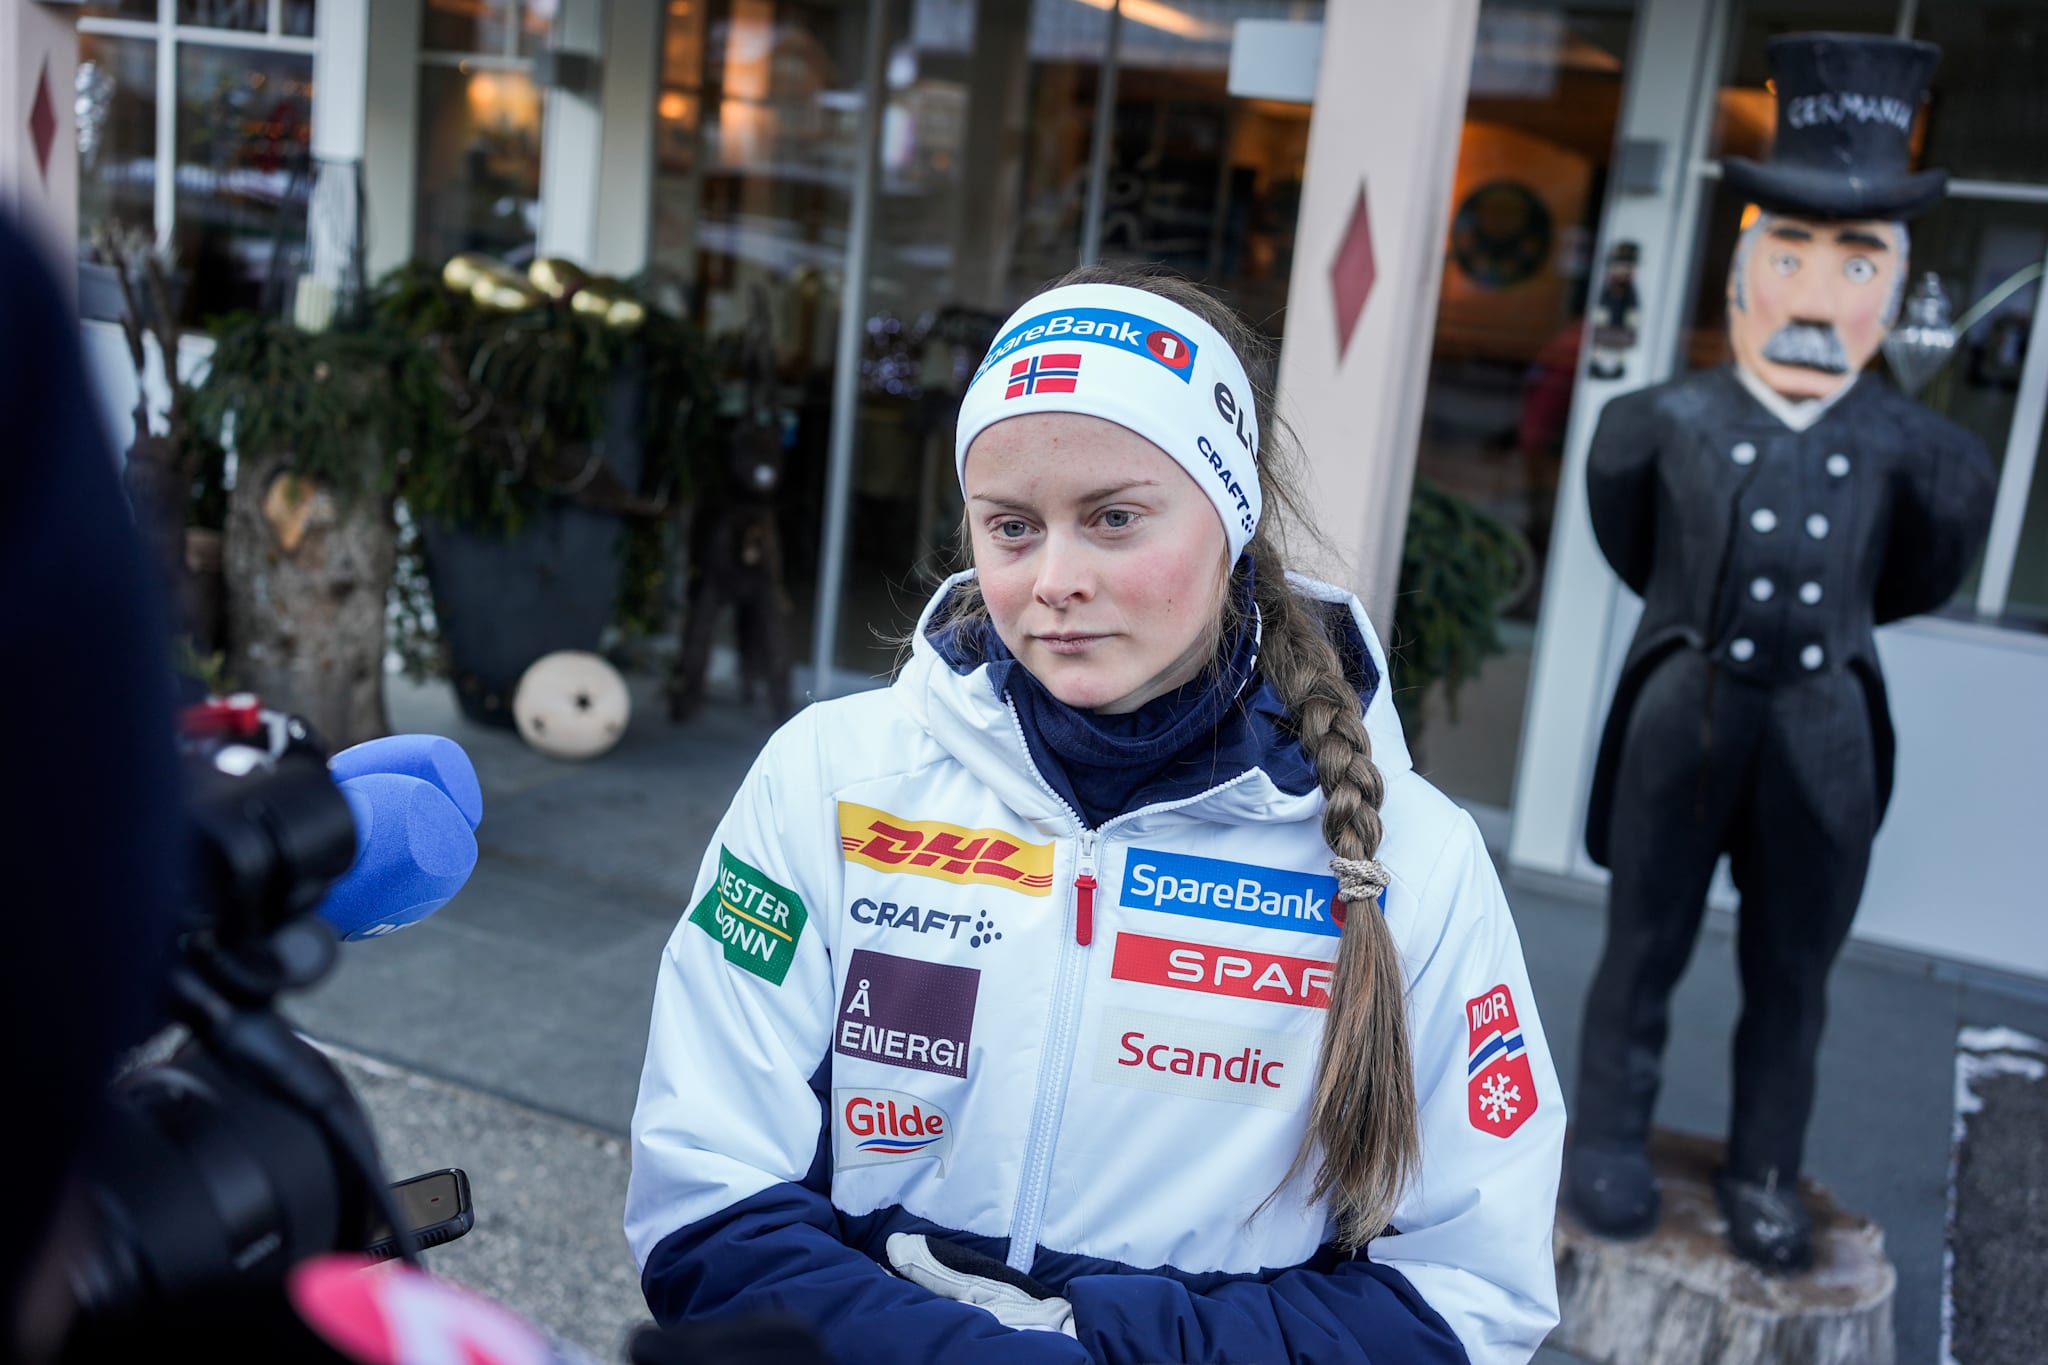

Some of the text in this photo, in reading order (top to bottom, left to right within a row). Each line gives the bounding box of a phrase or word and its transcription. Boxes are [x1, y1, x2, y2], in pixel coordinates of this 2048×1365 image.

[1159, 337, 1179, 360] 1
[1197, 436, 1250, 511] CRAFT
[859, 820, 1025, 881] DHL
[1130, 864, 1327, 922] SpareBank
[850, 897, 972, 940] CRAFT
[846, 978, 872, 1018] Å
[1167, 949, 1335, 999] SPAR
[1472, 992, 1510, 1032] NOR
[840, 1021, 965, 1069] ENERGI
[1117, 1031, 1285, 1089] Scandic
[845, 1096, 945, 1137] Gilde
